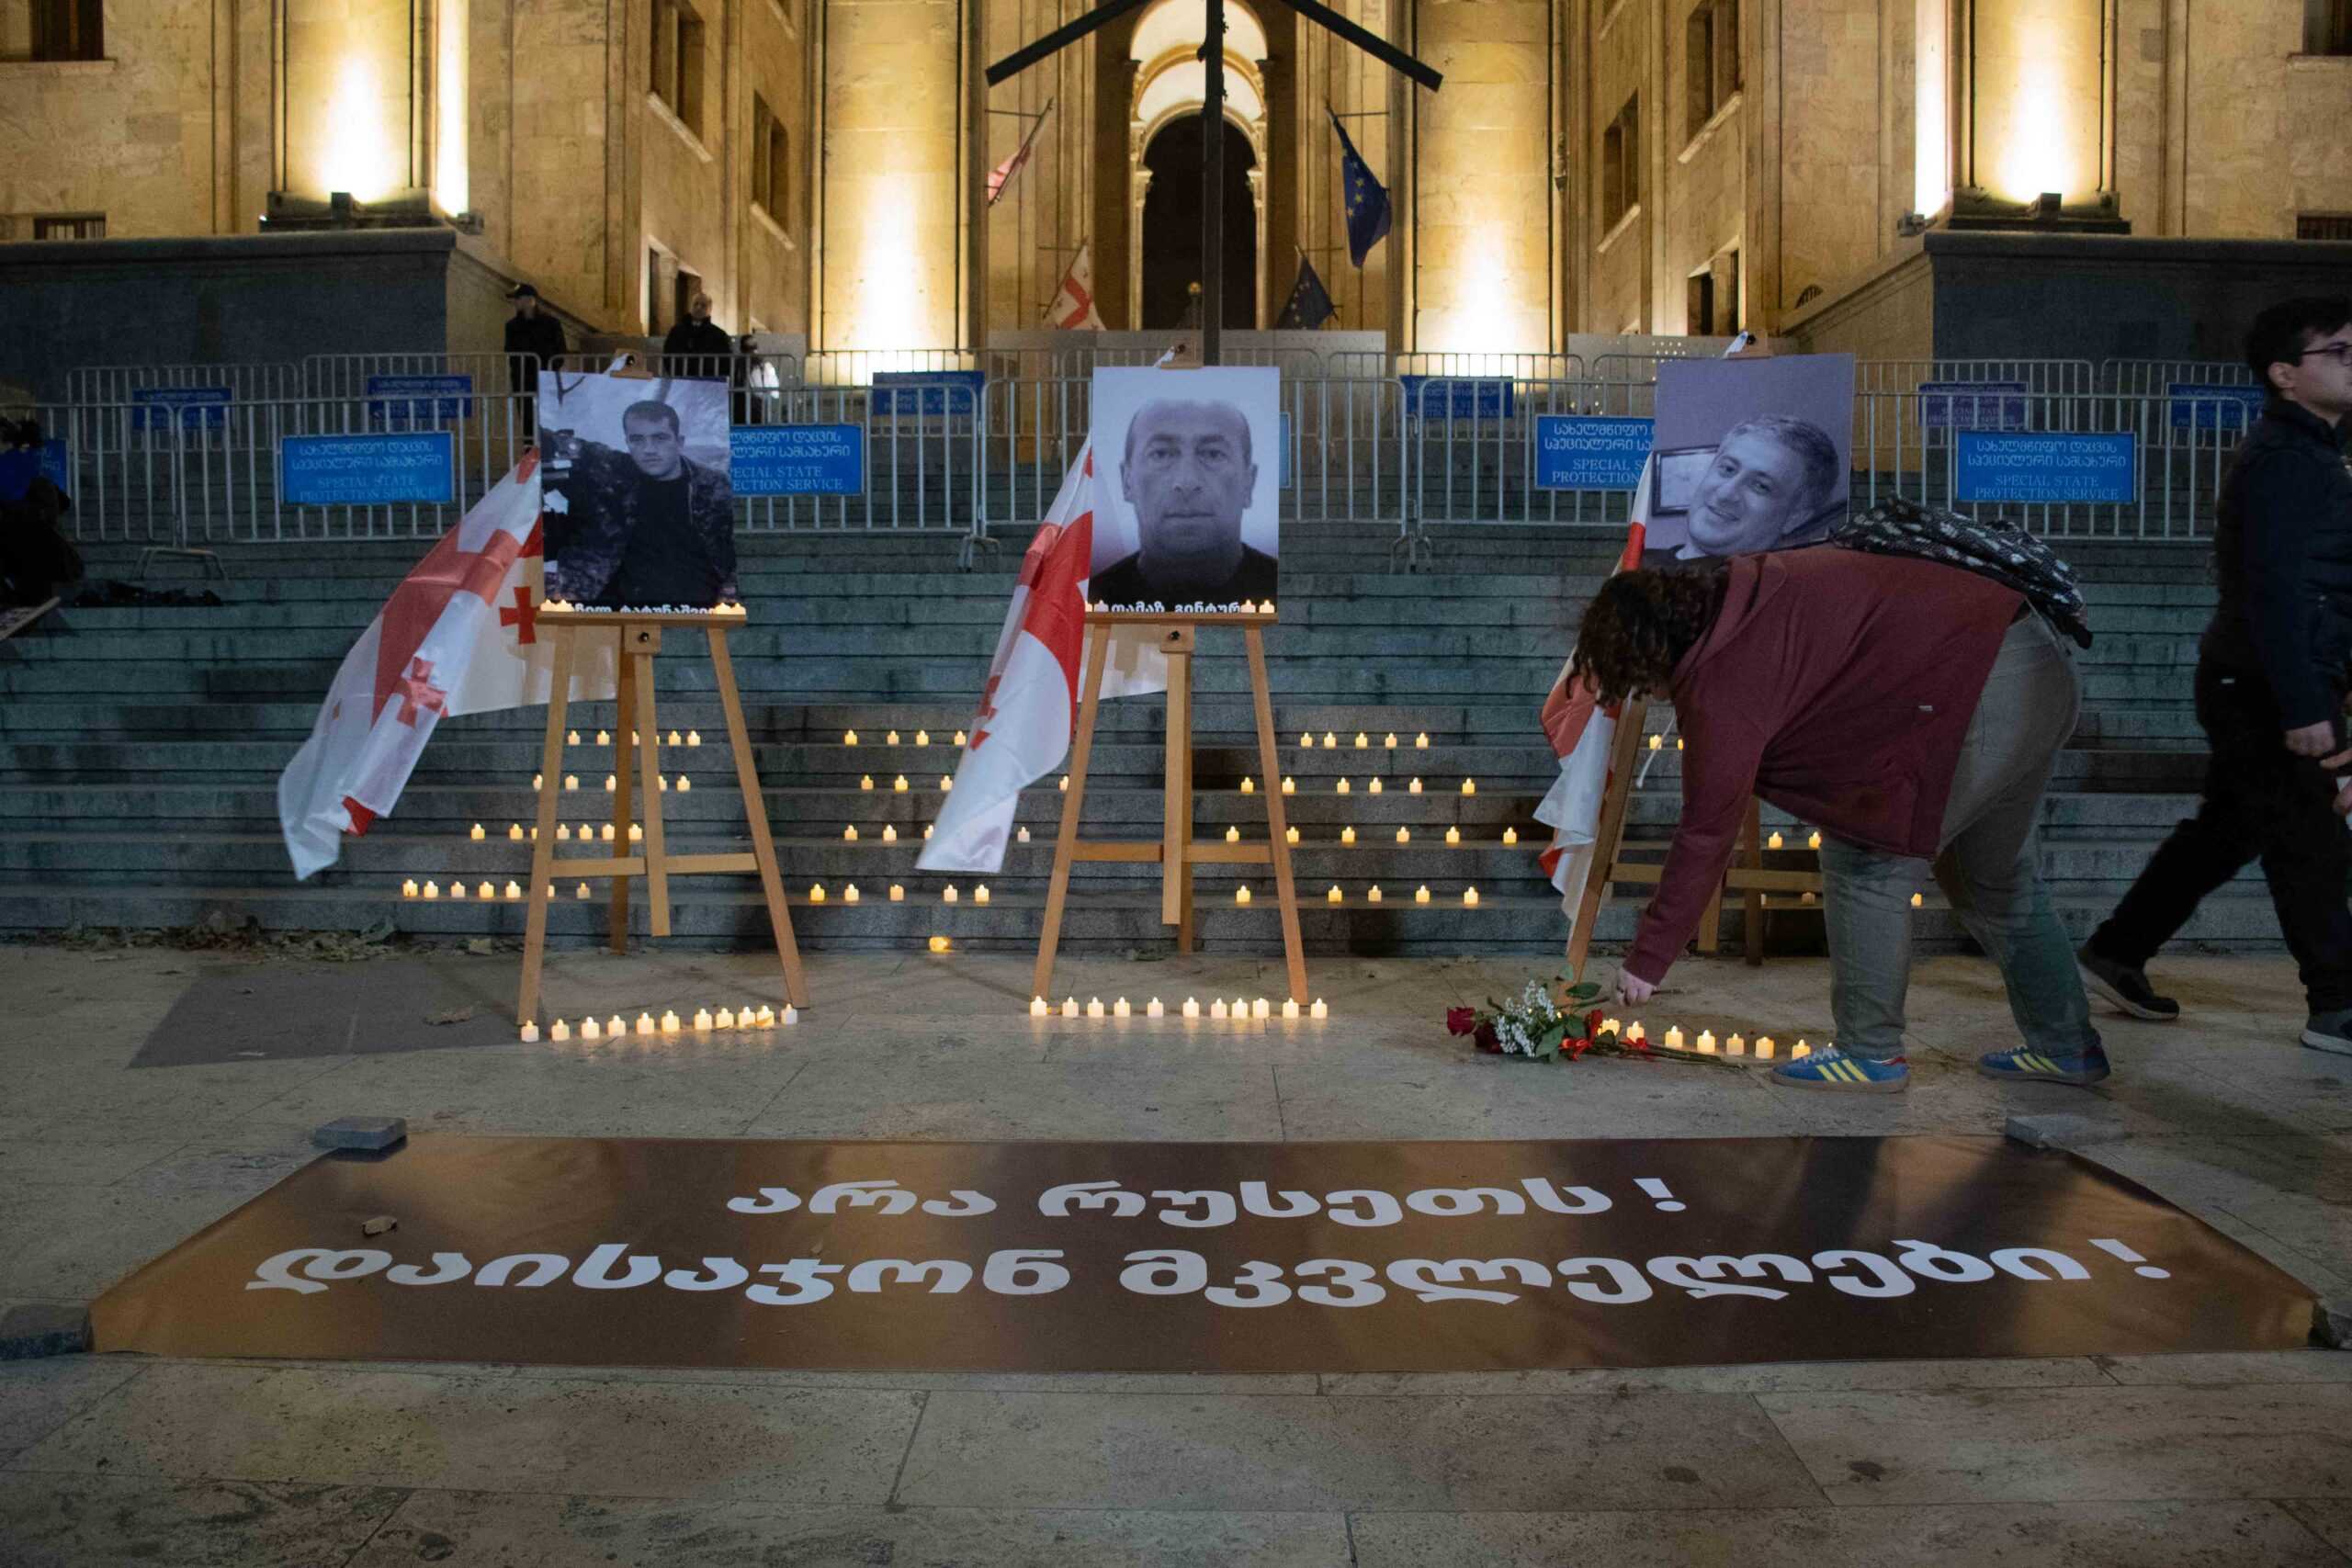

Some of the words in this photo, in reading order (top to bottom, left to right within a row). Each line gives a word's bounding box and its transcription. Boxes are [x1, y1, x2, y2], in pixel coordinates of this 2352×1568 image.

[1554, 423, 1647, 436] სახელმწიფო
[793, 431, 842, 443] დაცვის
[1544, 437, 1634, 451] სპეციალური
[1976, 440, 2066, 453] სახელმწიფო
[2070, 440, 2117, 453] დაცვის
[779, 446, 851, 457] სამსახური
[1573, 459, 1631, 471] SPECIAL
[777, 466, 823, 478] STATE
[318, 477, 368, 488] SPECIAL
[375, 475, 416, 487] STATE
[734, 479, 781, 491] ECTION
[786, 479, 843, 491] SERVICE
[1995, 475, 2050, 487] SPECIAL
[2054, 476, 2099, 487] STATE
[300, 491, 380, 502] PROTECTION
[384, 488, 438, 500] SERVICE
[1975, 488, 2060, 500] PROTECTION
[2064, 488, 2119, 500] SERVICE
[727, 1179, 997, 1217] არა
[1038, 1178, 1613, 1228] რუსეთს
[1633, 1178, 1687, 1213] !
[246, 1244, 1071, 1306] დაისაჯონ
[1119, 1239, 2092, 1309] მკვლელები
[2086, 1238, 2172, 1280] !
